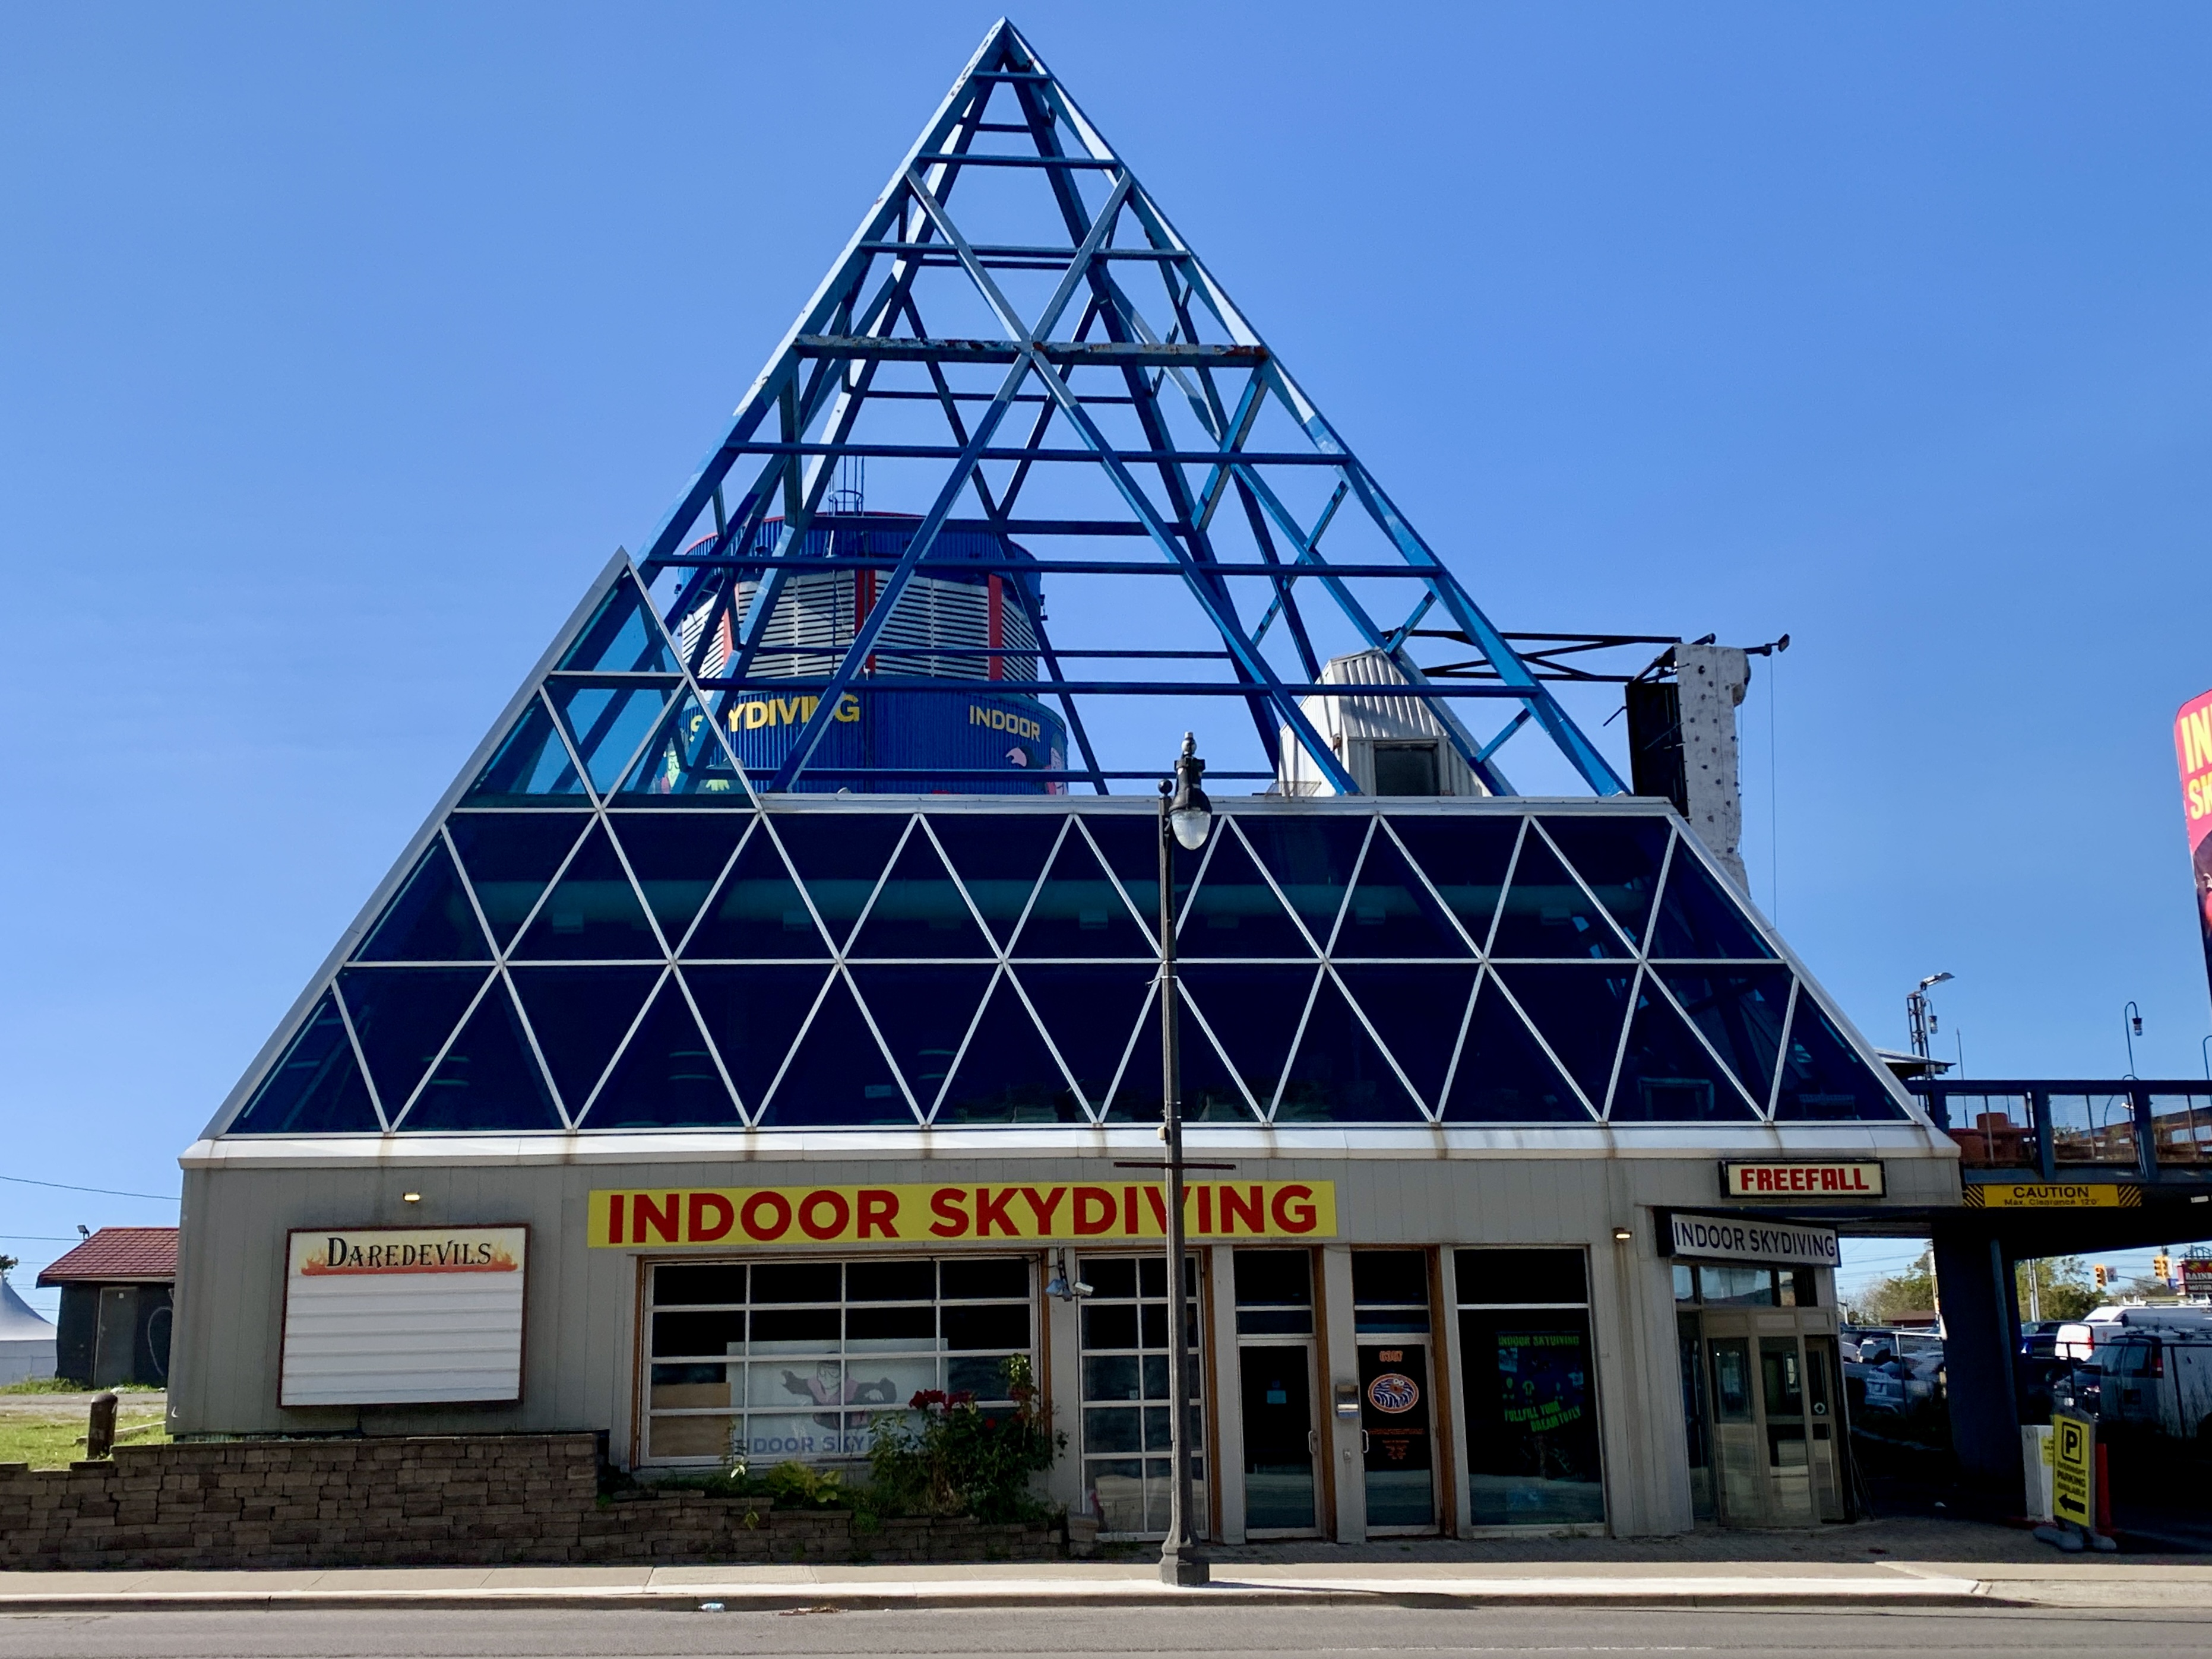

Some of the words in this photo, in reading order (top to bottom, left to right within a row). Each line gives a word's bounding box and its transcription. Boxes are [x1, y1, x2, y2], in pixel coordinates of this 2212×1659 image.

[969, 704, 1040, 743] INDOOR
[2180, 702, 2212, 774] IN
[1741, 1167, 1869, 1191] FREEFALL
[2012, 1186, 2089, 1198] CAUTION
[608, 1188, 900, 1244] INDOOR
[928, 1184, 1317, 1237] SKYDIVING
[1675, 1221, 1745, 1251] INDOOR
[1748, 1229, 1836, 1258] SKYDIVING
[2065, 1430, 2078, 1455] P
[2057, 1470, 2086, 1488] PARKING
